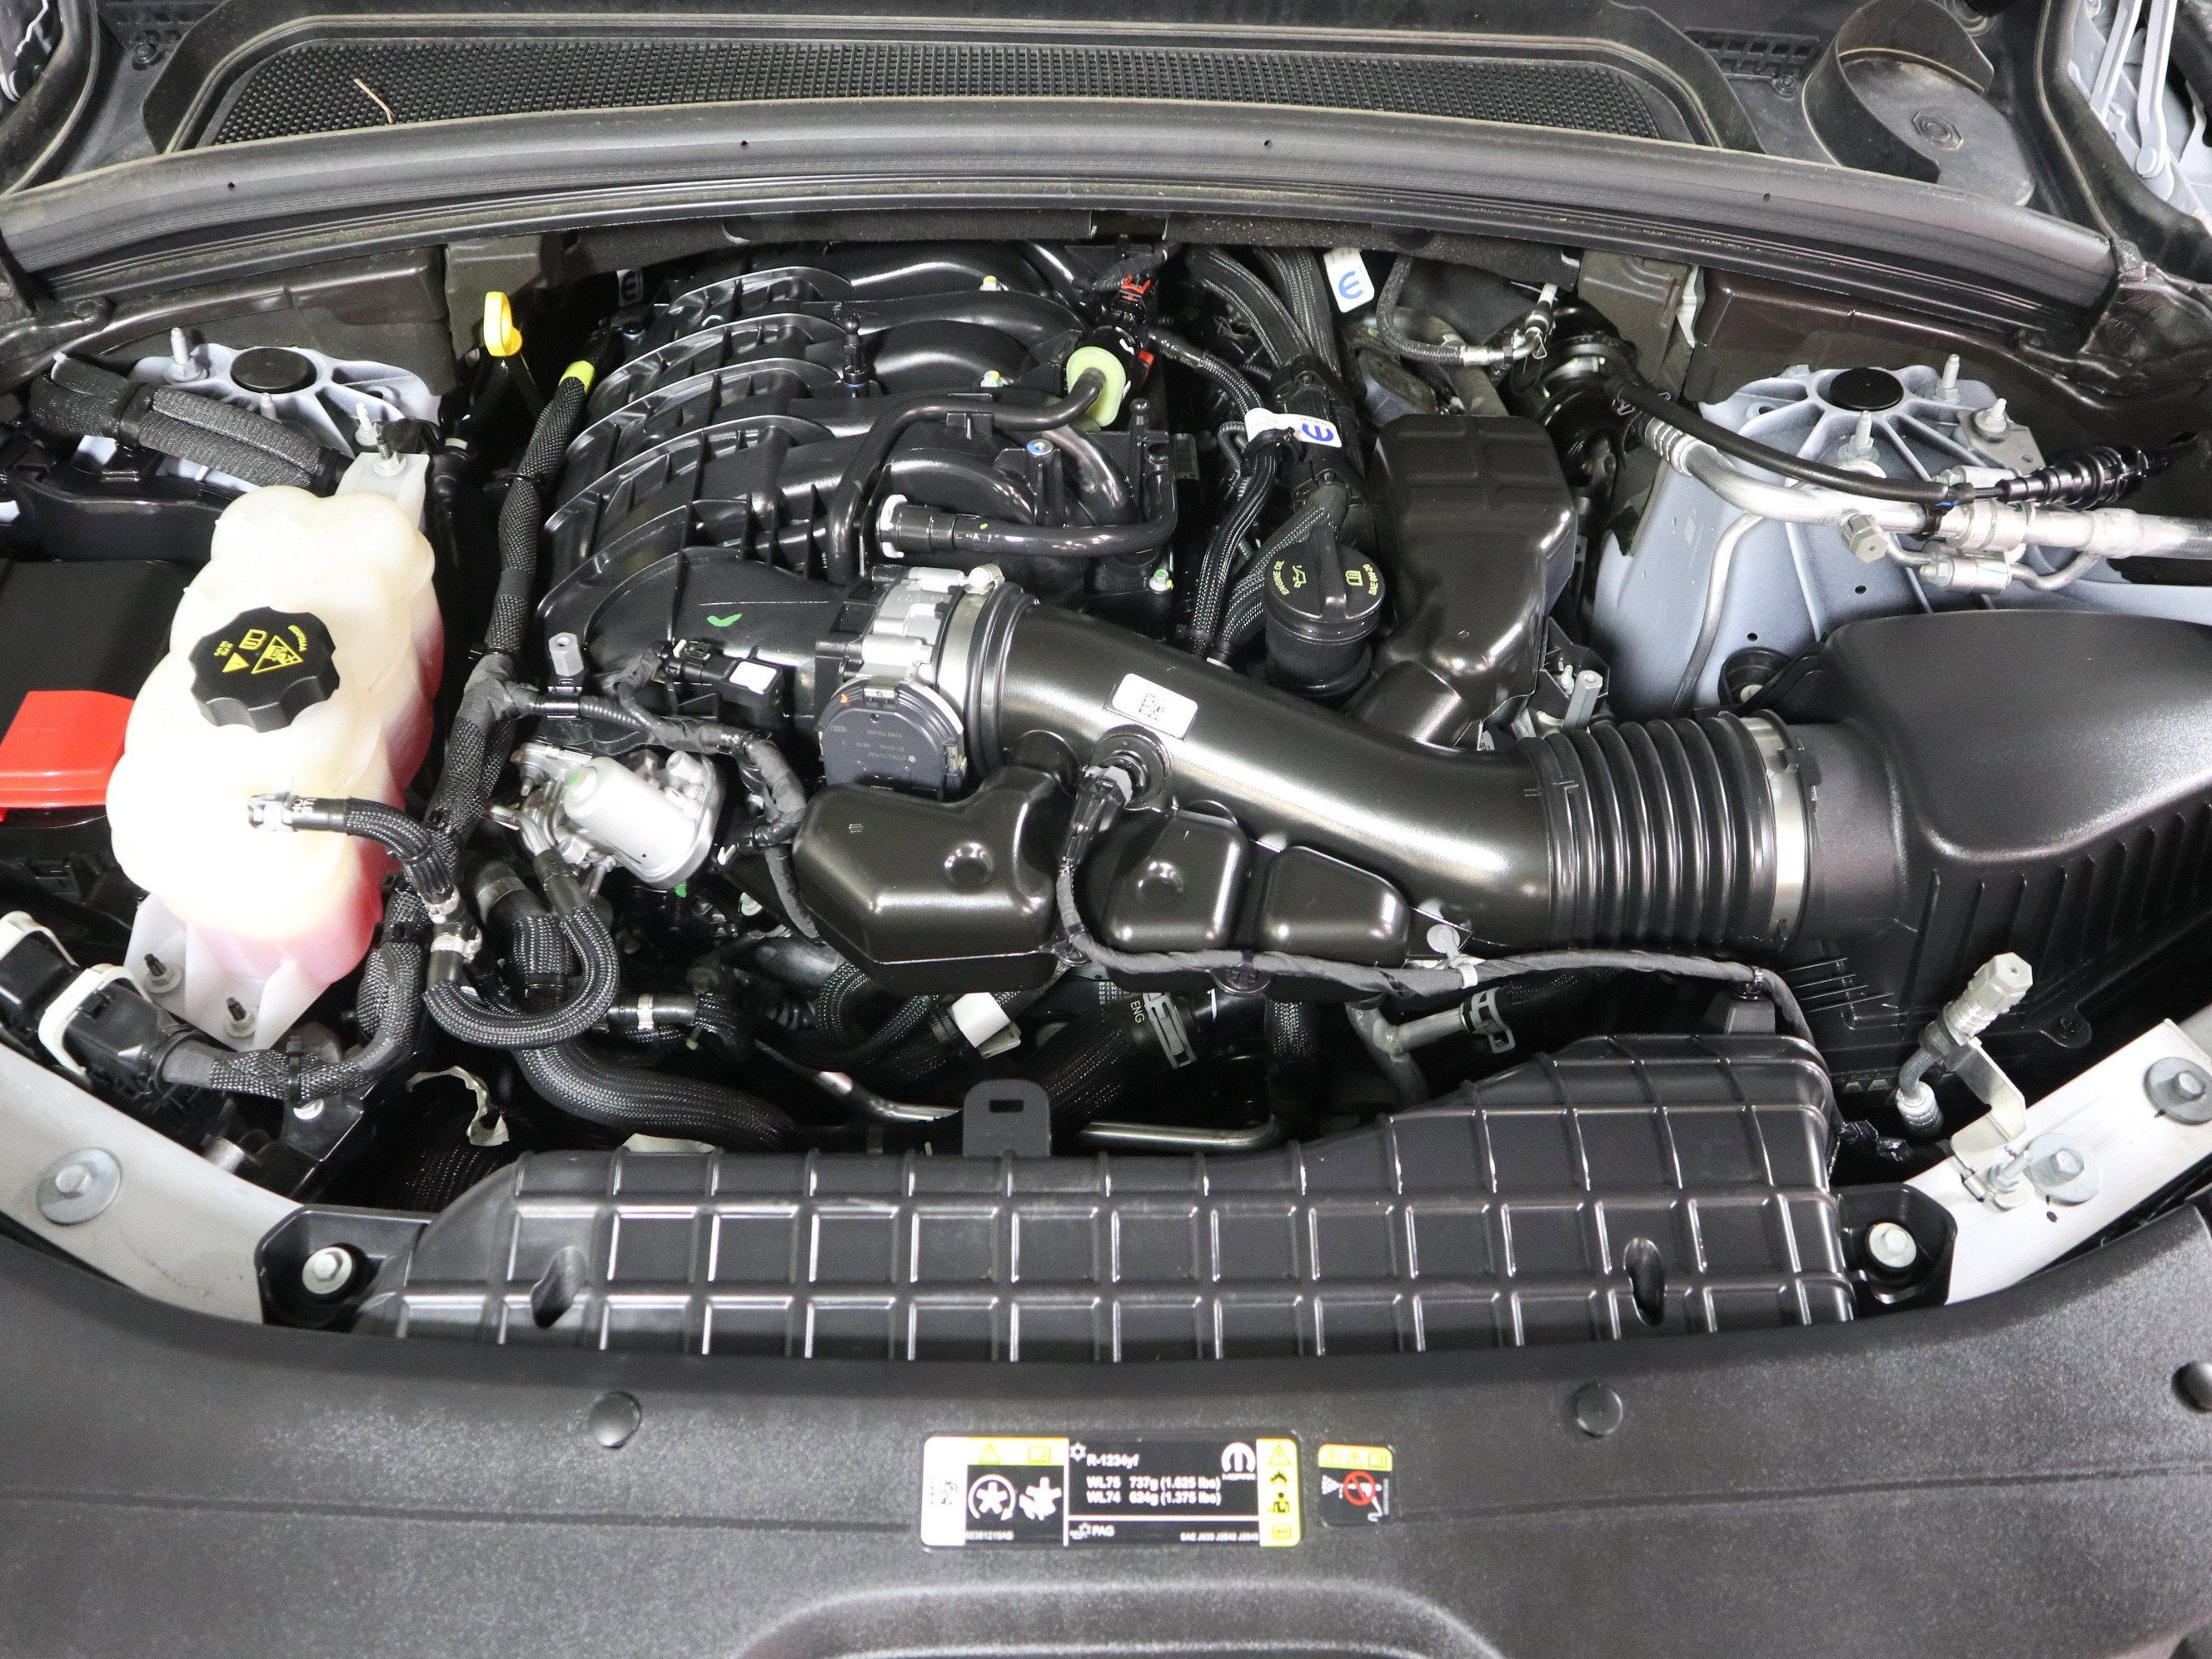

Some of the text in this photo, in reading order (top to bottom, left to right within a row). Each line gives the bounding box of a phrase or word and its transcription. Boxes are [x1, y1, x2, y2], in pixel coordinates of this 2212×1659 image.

[1273, 560, 1289, 595] ENGINE OIL
[1368, 581, 1379, 596] SAE
[1130, 999, 1145, 1024] ENG
[1086, 1453, 1140, 1469] R-1234yf
[1086, 1476, 1121, 1489] WL75
[1129, 1476, 1158, 1492] 737g
[1198, 1476, 1221, 1492] lbs)
[1086, 1491, 1121, 1504] WL74
[1129, 1491, 1158, 1507] 624g
[1198, 1491, 1221, 1507] lbs)
[1092, 1525, 1115, 1537] PAG
